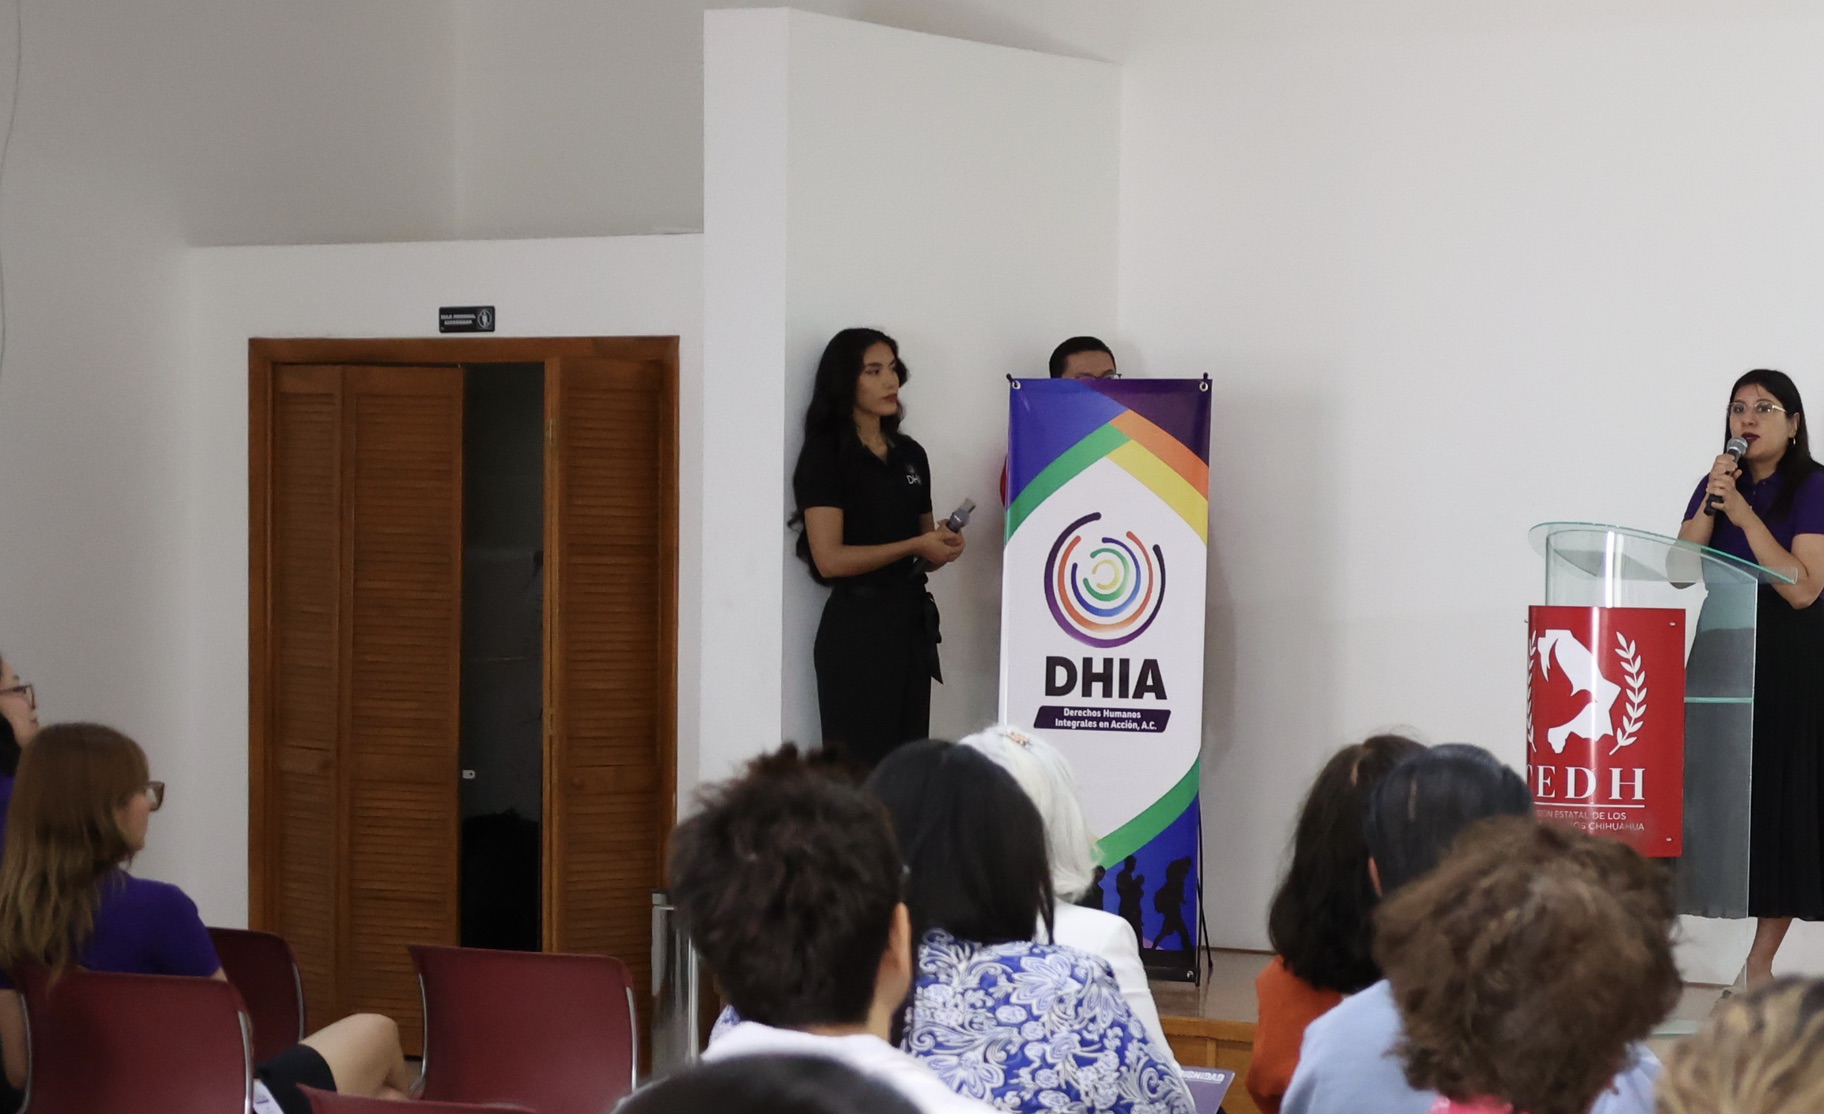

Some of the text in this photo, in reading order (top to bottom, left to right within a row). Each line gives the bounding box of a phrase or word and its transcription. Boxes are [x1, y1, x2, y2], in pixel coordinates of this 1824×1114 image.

[1045, 656, 1167, 700] DHIA
[1064, 708, 1141, 718] Derechos Humanos
[1055, 719, 1097, 729] Integrales
[1111, 720, 1140, 730] Acción,
[1527, 764, 1645, 800] EDH
[1592, 811, 1606, 820] DE
[1607, 811, 1627, 821] LOS
